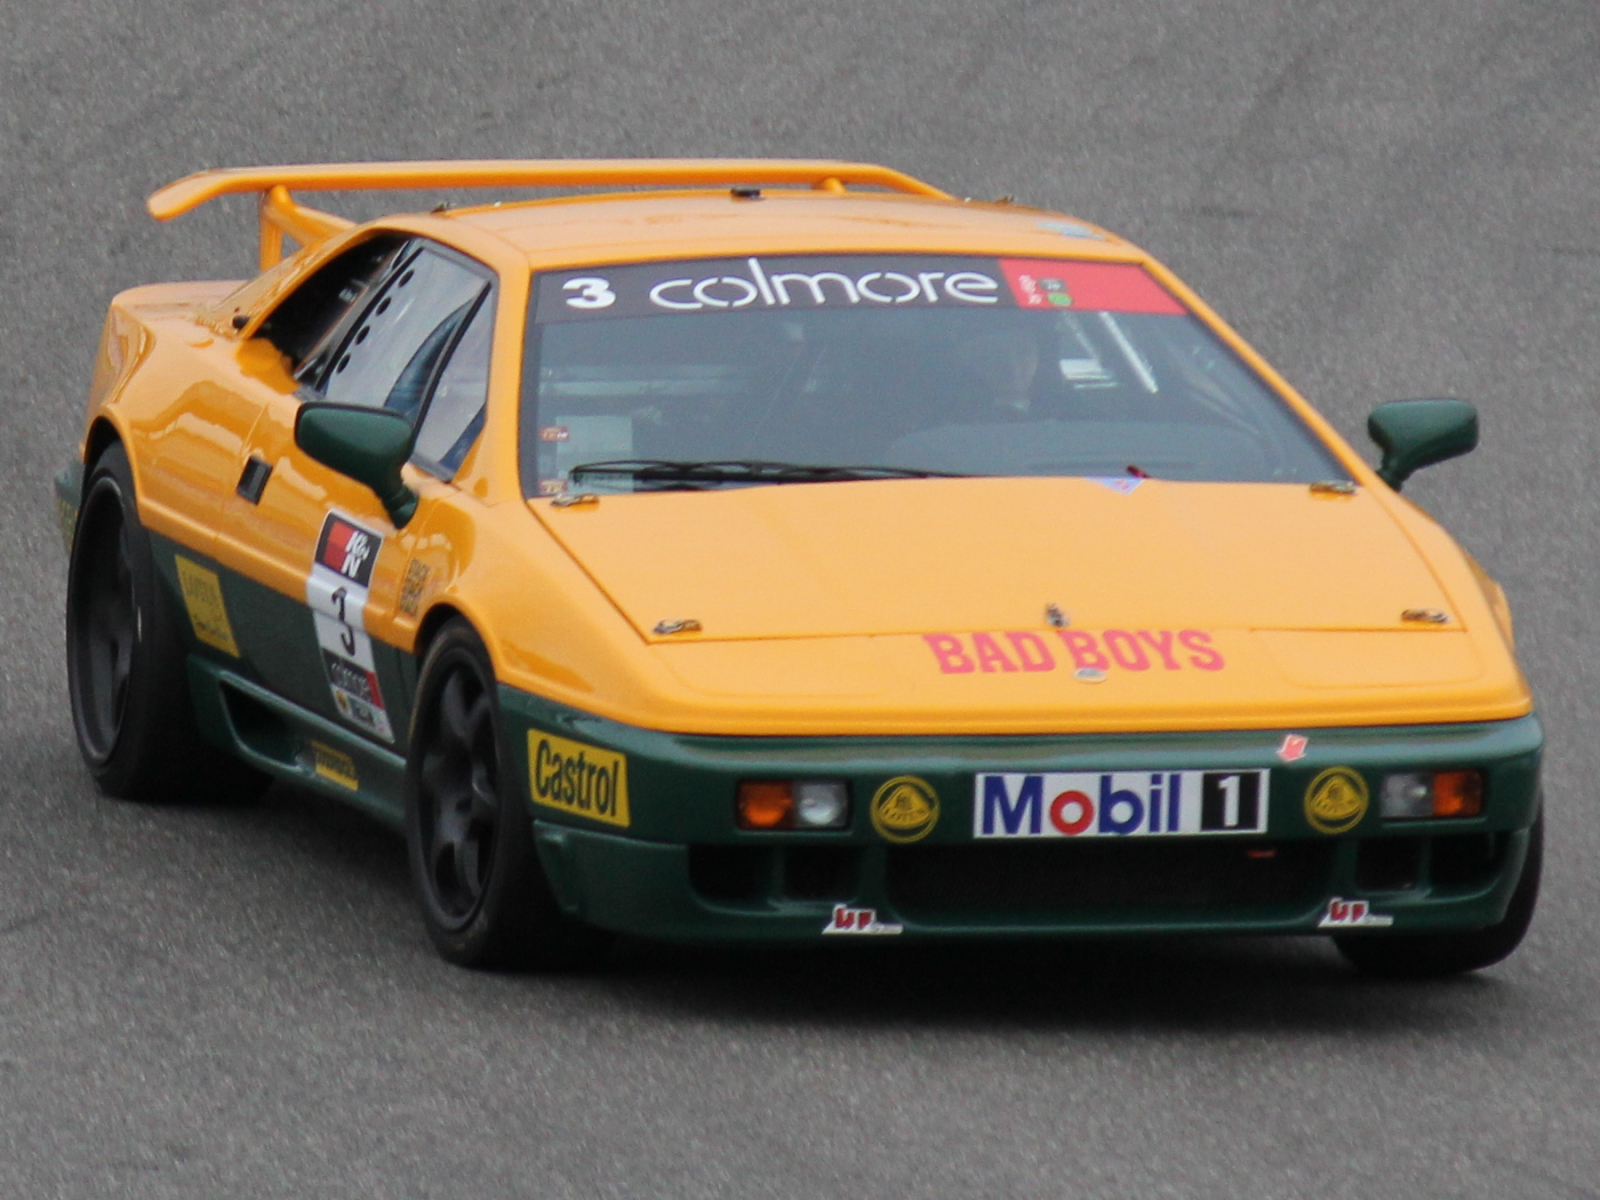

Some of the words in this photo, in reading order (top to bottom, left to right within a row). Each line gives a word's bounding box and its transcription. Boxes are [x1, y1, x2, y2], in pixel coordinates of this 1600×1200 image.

[562, 276, 616, 309] 3
[649, 257, 999, 310] colmore
[331, 586, 356, 657] 3
[922, 631, 1057, 675] BAD
[1058, 629, 1226, 672] BOYS
[535, 738, 620, 818] Castrol
[981, 773, 1182, 836] Mobil
[1218, 775, 1242, 828] 1
